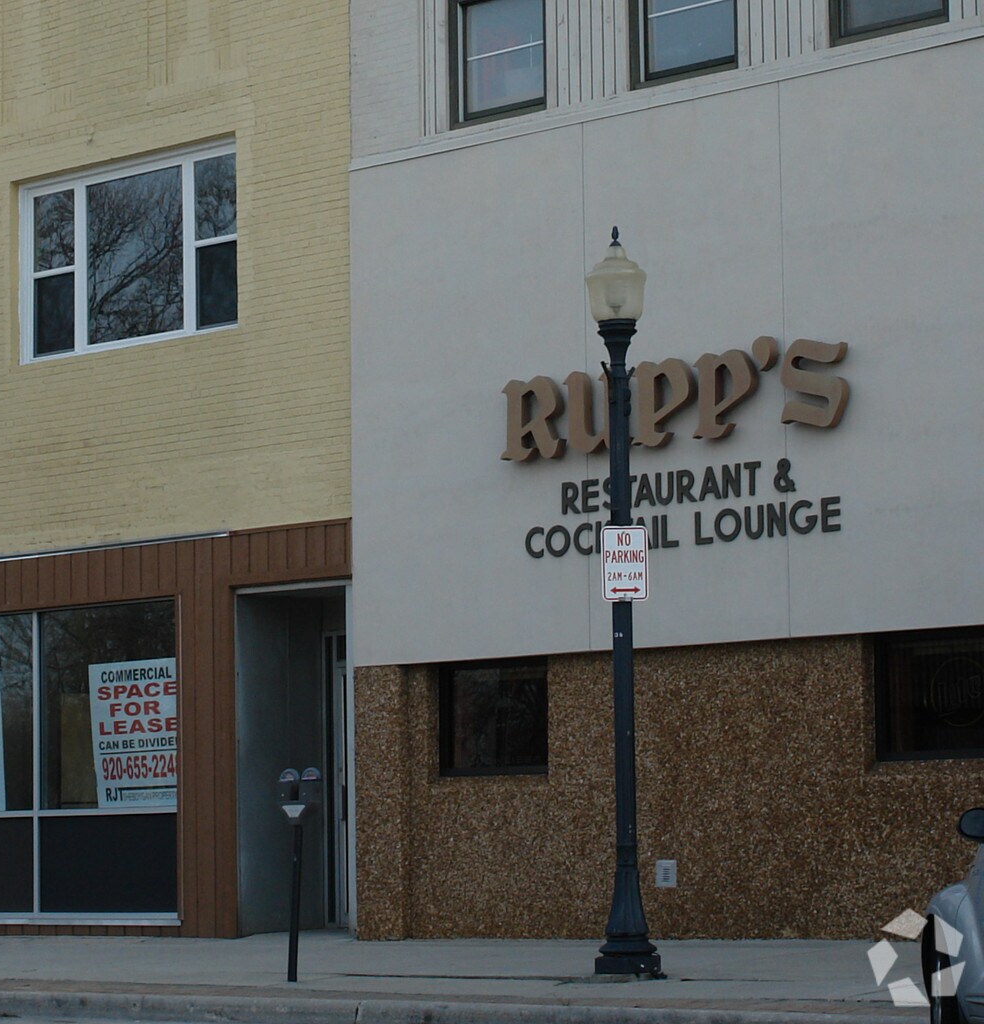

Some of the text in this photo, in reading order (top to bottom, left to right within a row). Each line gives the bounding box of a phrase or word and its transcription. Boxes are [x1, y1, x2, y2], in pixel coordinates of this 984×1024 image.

[773, 457, 797, 493] &
[525, 496, 841, 559] COCIL LOUNGE
[617, 532, 631, 547] NO
[605, 549, 644, 564] PARKING
[101, 666, 172, 684] COMMERCIAL
[97, 681, 177, 701] SPACE
[109, 701, 161, 717] FOR
[99, 717, 177, 736] LEASE
[99, 736, 177, 751] CAN BE DIVIDE
[102, 753, 177, 781] 920-655-224
[105, 787, 124, 803] RJT
